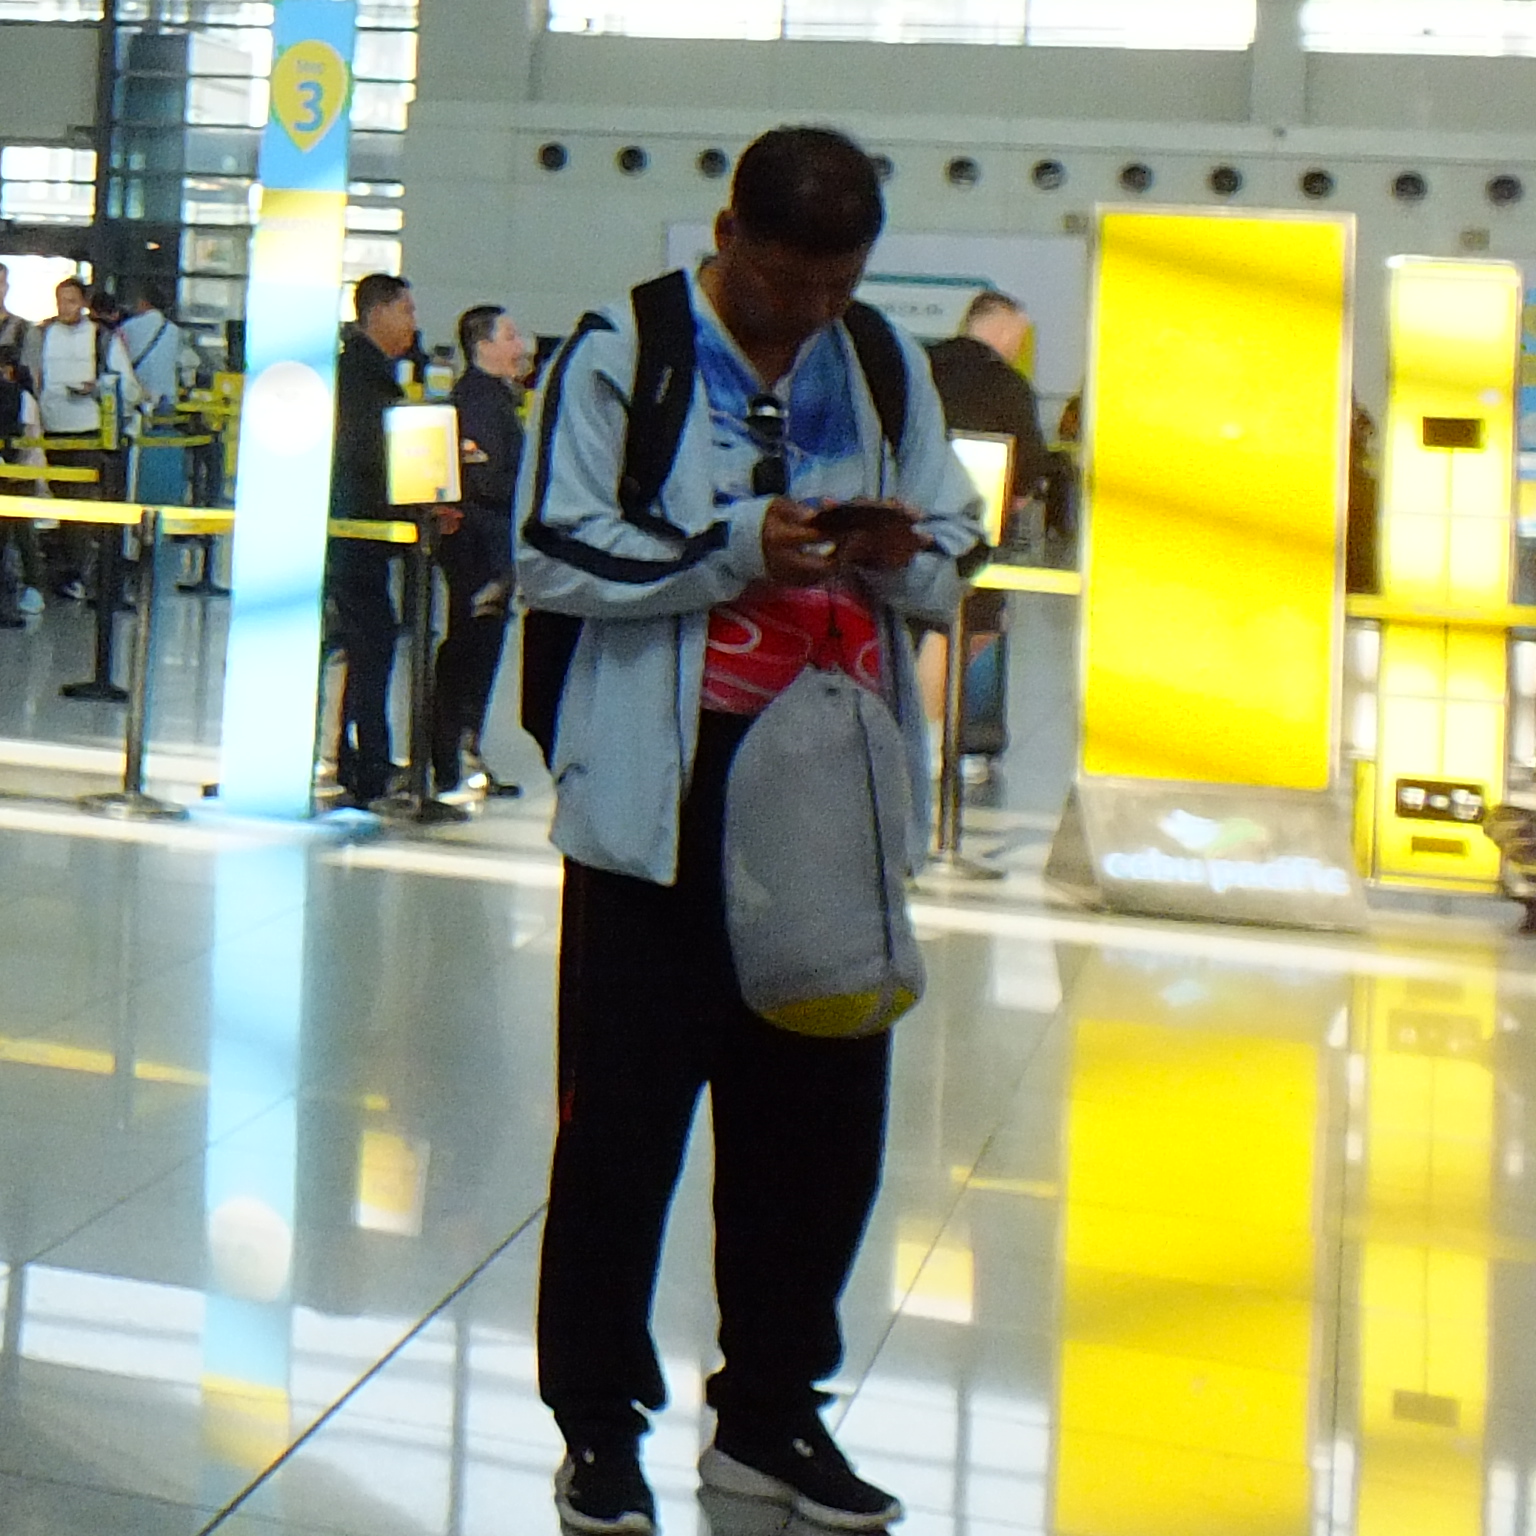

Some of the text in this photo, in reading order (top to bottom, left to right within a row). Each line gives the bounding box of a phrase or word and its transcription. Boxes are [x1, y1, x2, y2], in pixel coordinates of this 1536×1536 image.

[294, 80, 324, 132] 3
[1103, 847, 1350, 894] cebu pacific
